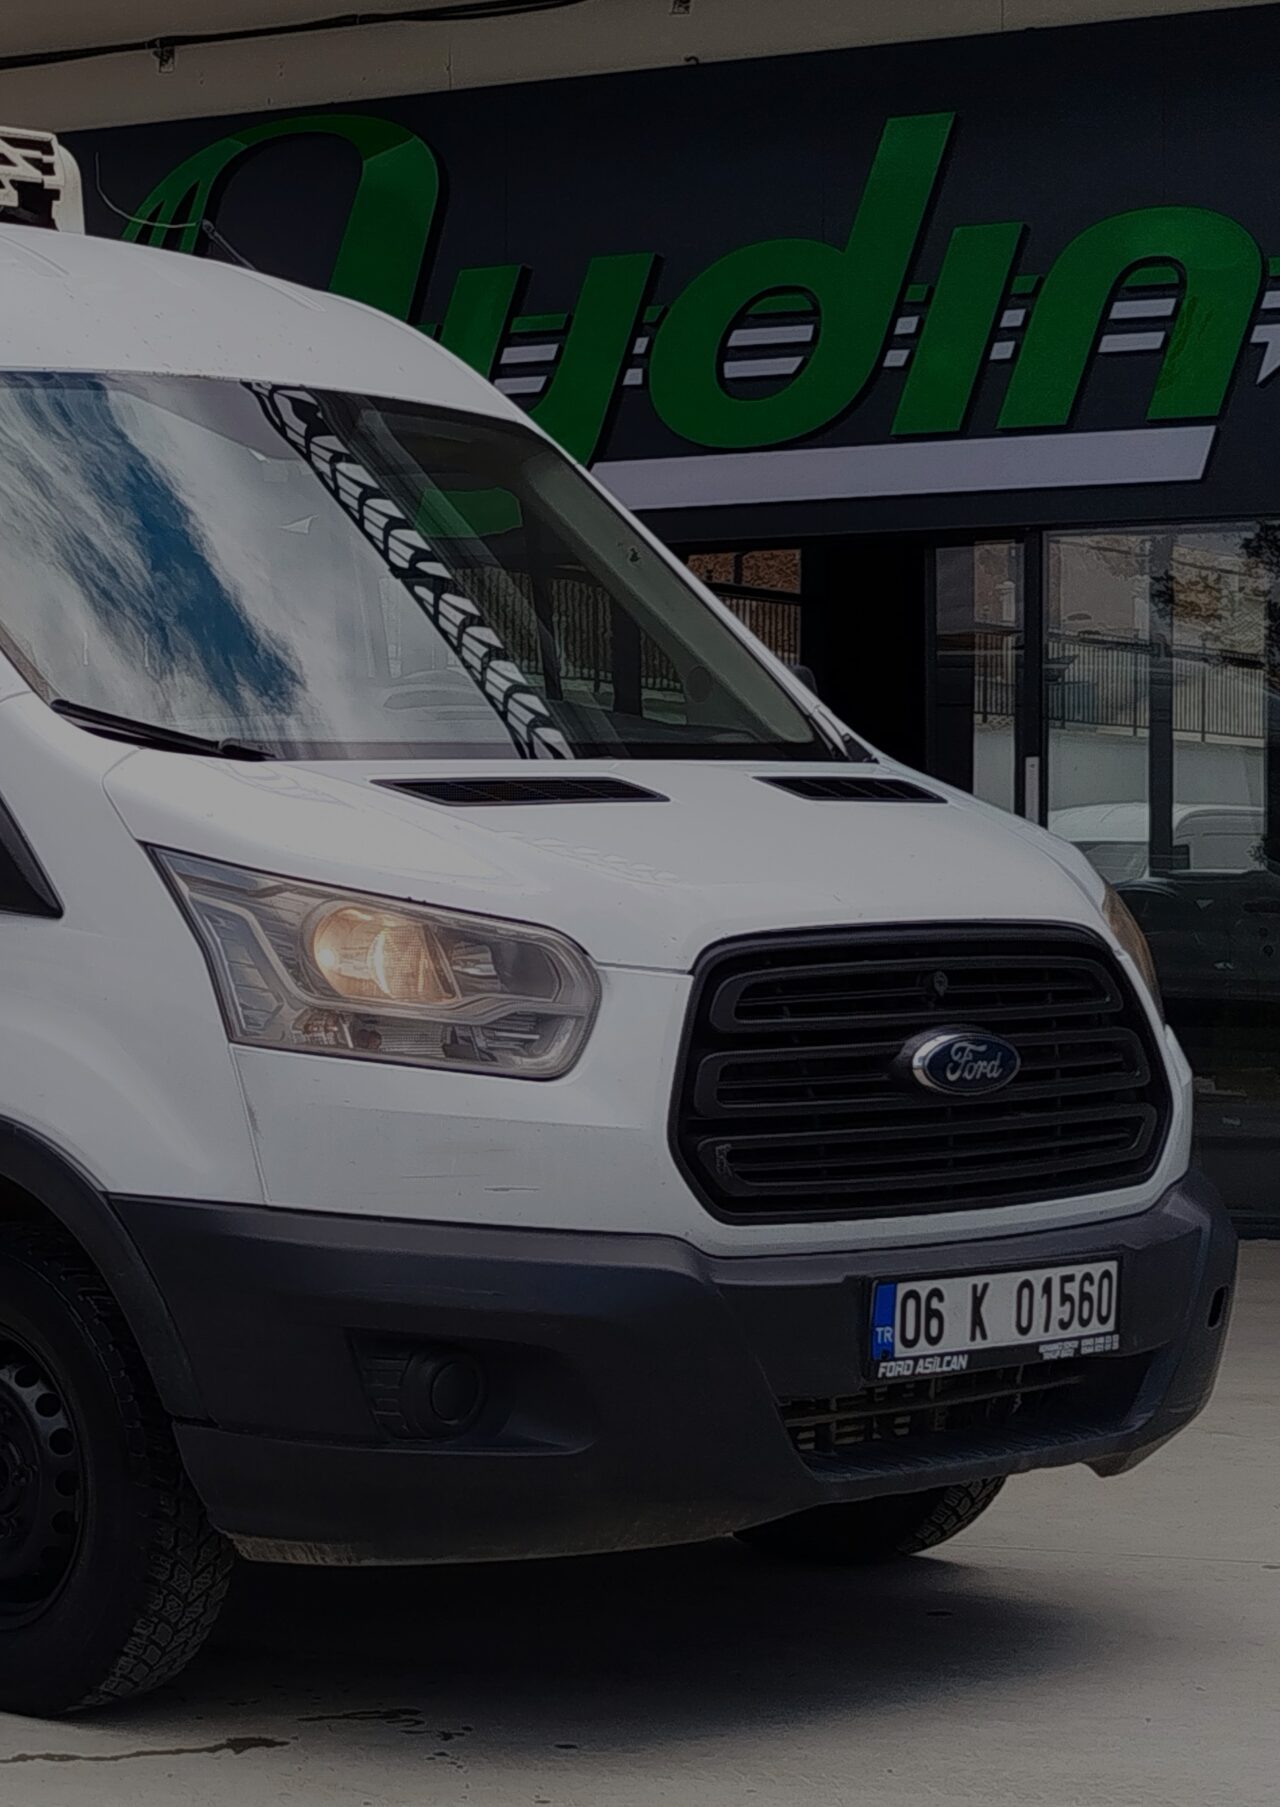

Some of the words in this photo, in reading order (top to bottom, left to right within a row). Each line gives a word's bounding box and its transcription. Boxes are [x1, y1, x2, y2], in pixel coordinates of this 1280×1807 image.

[945, 1041, 1003, 1082] Ford
[900, 1287, 945, 1349] 06
[969, 1282, 990, 1342] K
[1015, 1269, 1113, 1336] 01560
[875, 1326, 893, 1344] TR
[877, 1359, 914, 1378] FORD
